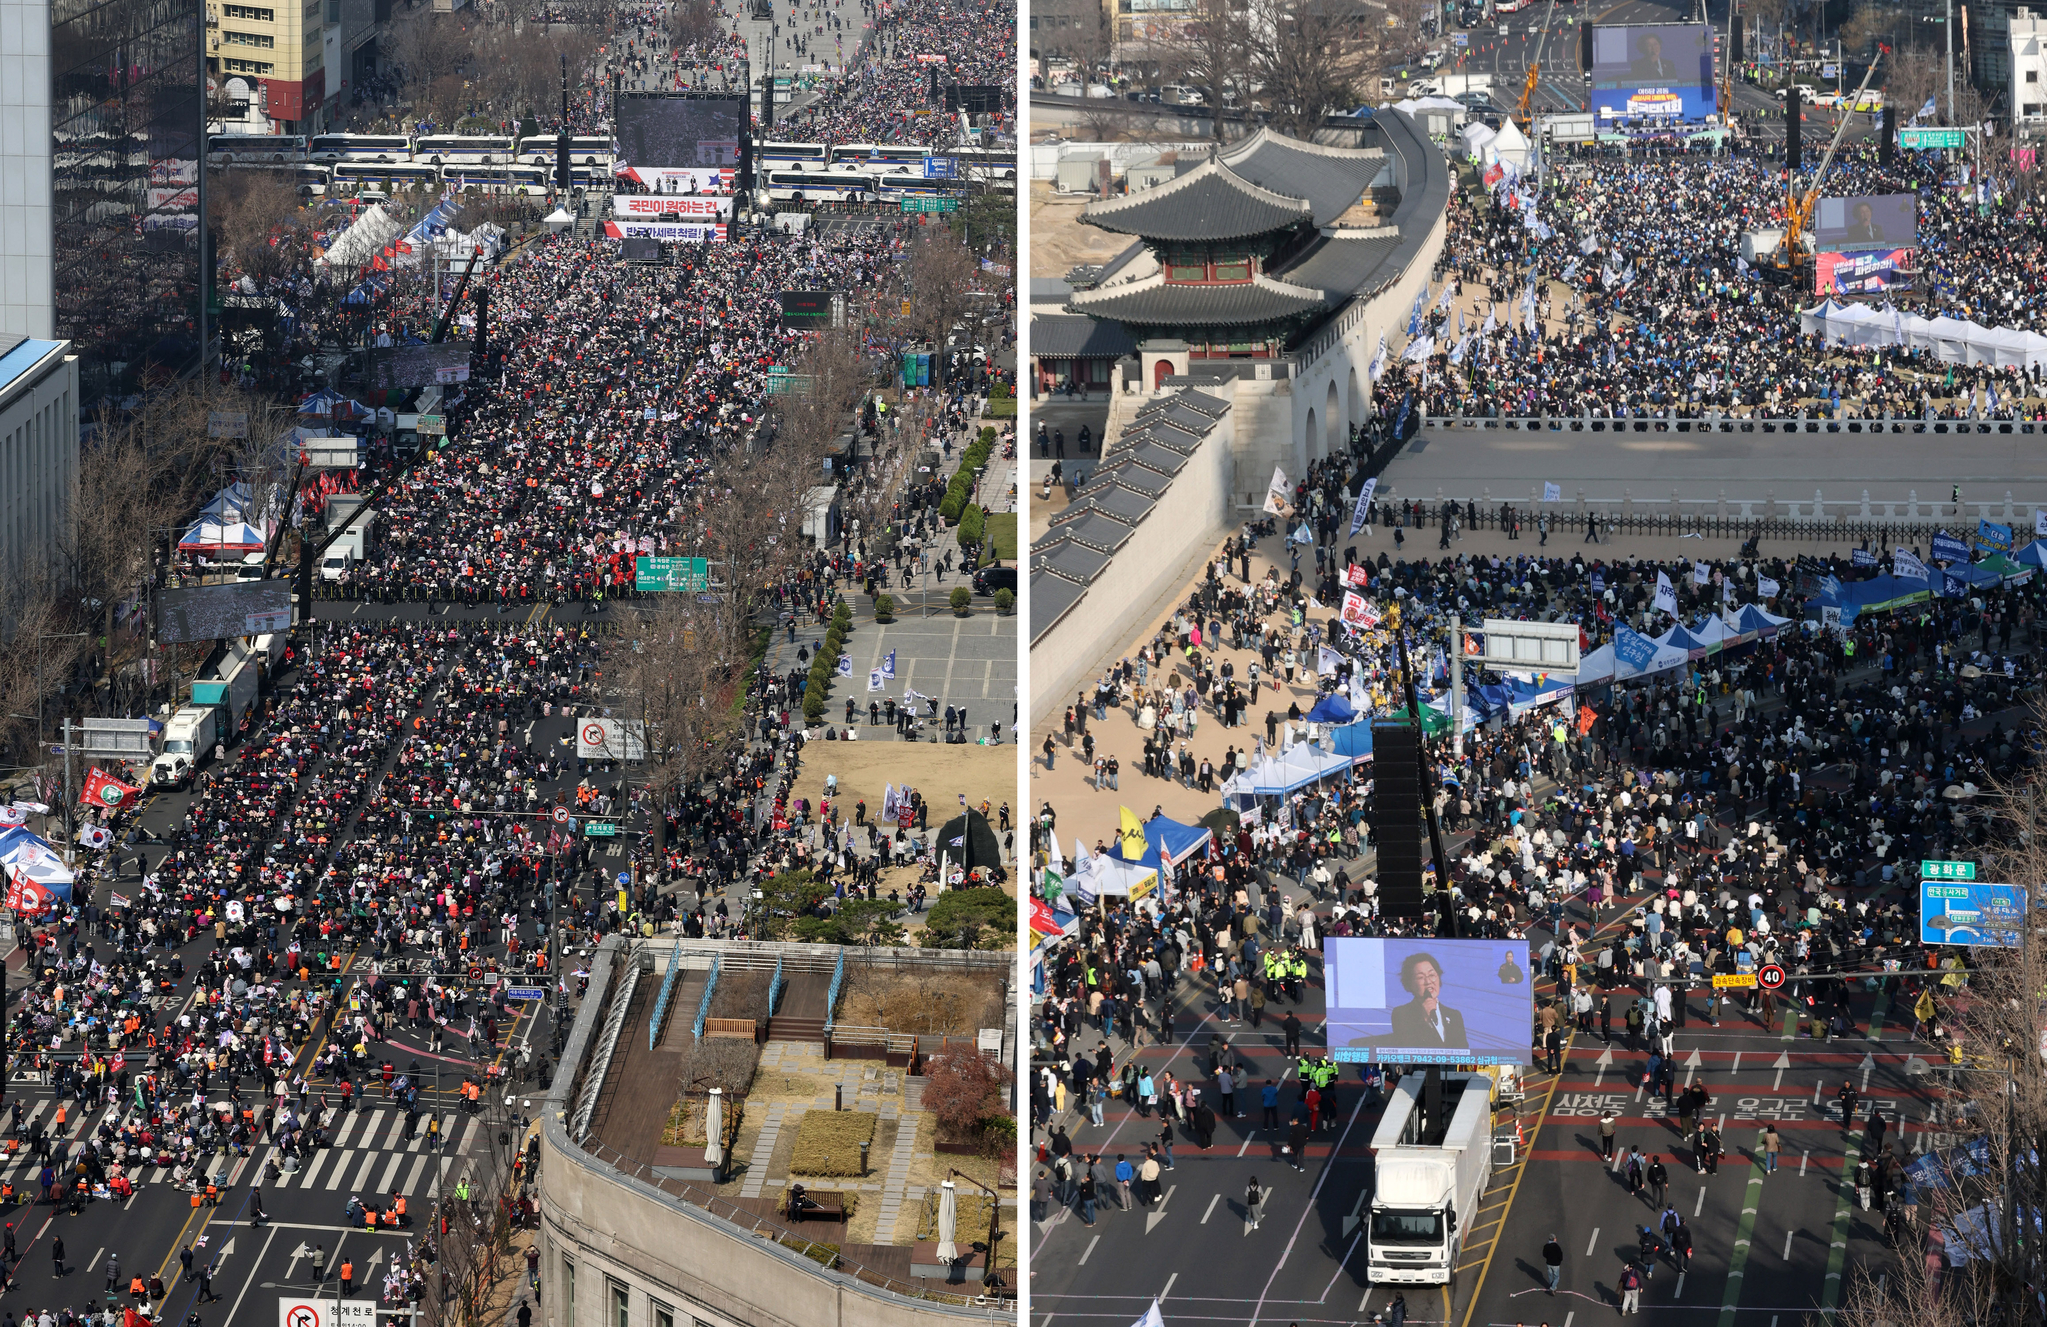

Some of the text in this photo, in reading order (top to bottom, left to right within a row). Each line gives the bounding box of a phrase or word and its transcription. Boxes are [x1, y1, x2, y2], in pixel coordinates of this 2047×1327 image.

[1627, 98, 1683, 114] 범국민대회
[629, 200, 718, 214] 국민이 원하는 건
[677, 227, 702, 239] 척결!
[1855, 258, 1893, 276] 파면하라!
[1622, 631, 1654, 655] 통일시대
[1622, 645, 1645, 663] 연구원
[1929, 863, 1967, 876] 광화문
[1928, 887, 1968, 897] 안국동사거리
[1715, 976, 1754, 985] 과속단속장비
[1764, 971, 1780, 982] 40
[1333, 1051, 1370, 1063] 비상행동
[1376, 1054, 1411, 1063] 카카오뱅크
[1412, 1055, 1476, 1064] 7942-09-53862
[1476, 1055, 1498, 1065] 심규협
[1553, 1094, 1628, 1118] 삼청동
[1733, 1098, 1808, 1121] 율곡로
[331, 1305, 374, 1317] 청계천로
